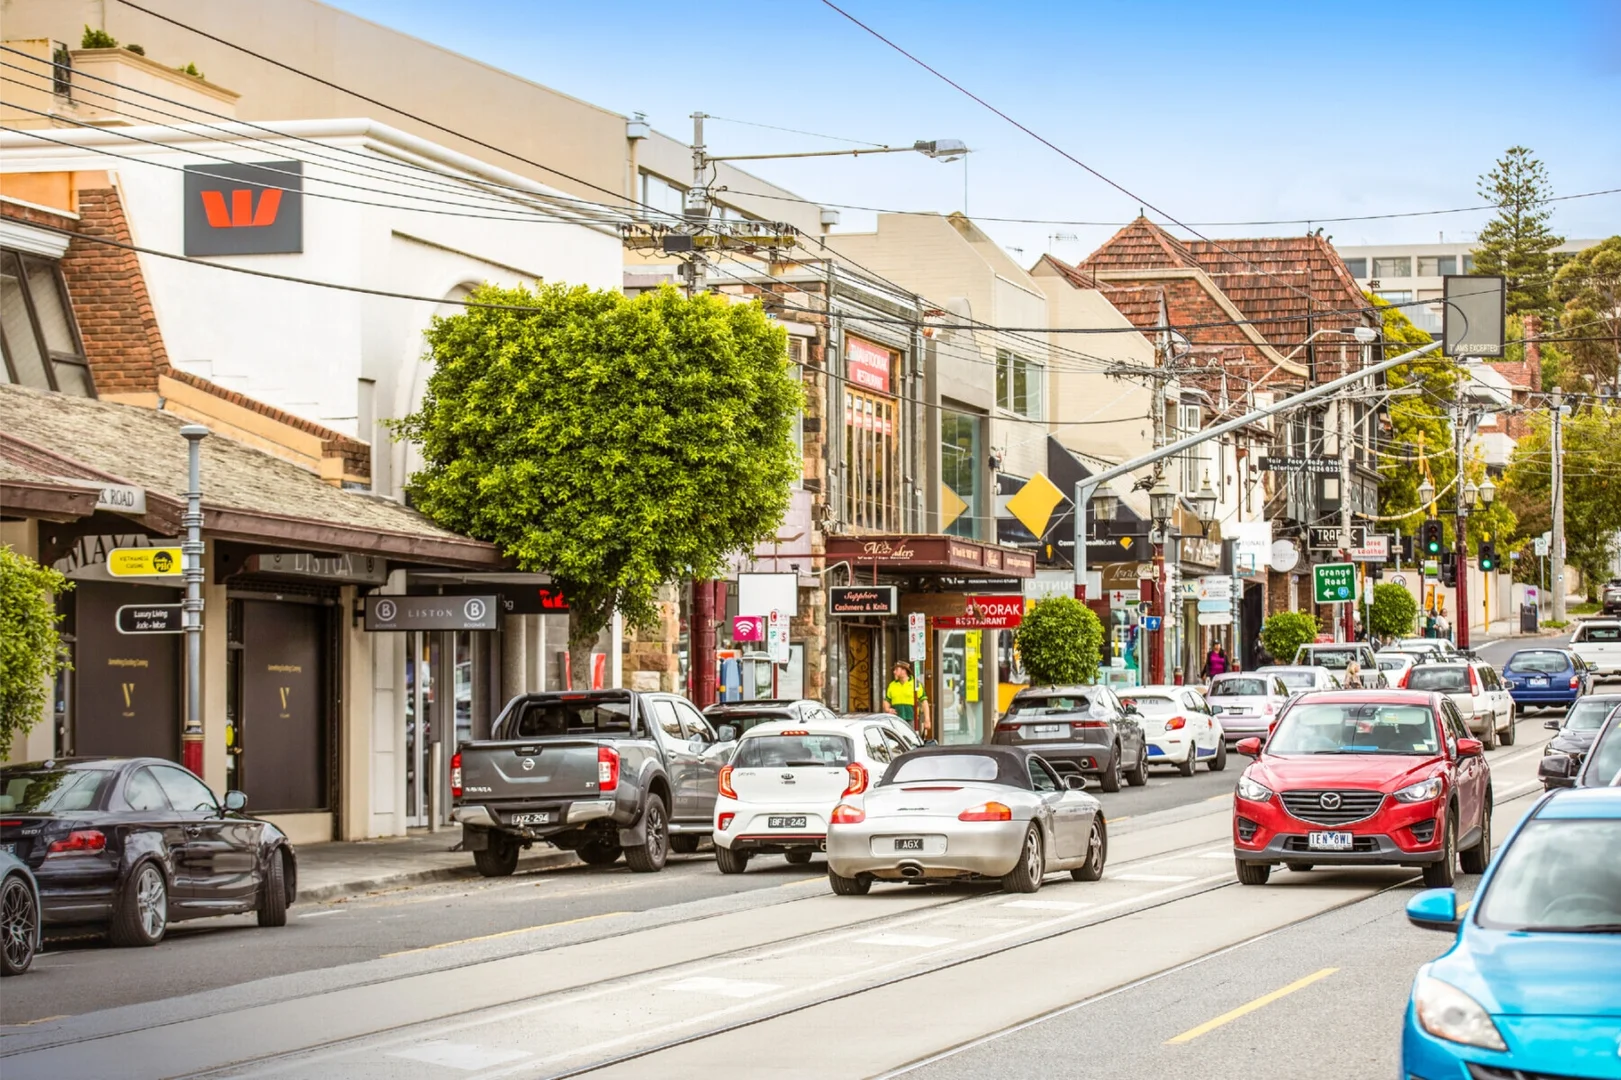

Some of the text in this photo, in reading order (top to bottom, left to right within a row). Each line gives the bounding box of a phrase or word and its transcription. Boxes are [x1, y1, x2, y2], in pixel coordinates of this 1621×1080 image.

[110, 489, 134, 507] ROAD
[1319, 568, 1351, 578] Grange
[1324, 578, 1346, 586] Road
[843, 591, 878, 602] Sapphire
[834, 603, 864, 611] Cashmere
[873, 602, 888, 611] Knits
[408, 608, 453, 618] LISTON
[902, 840, 919, 849] AGX
